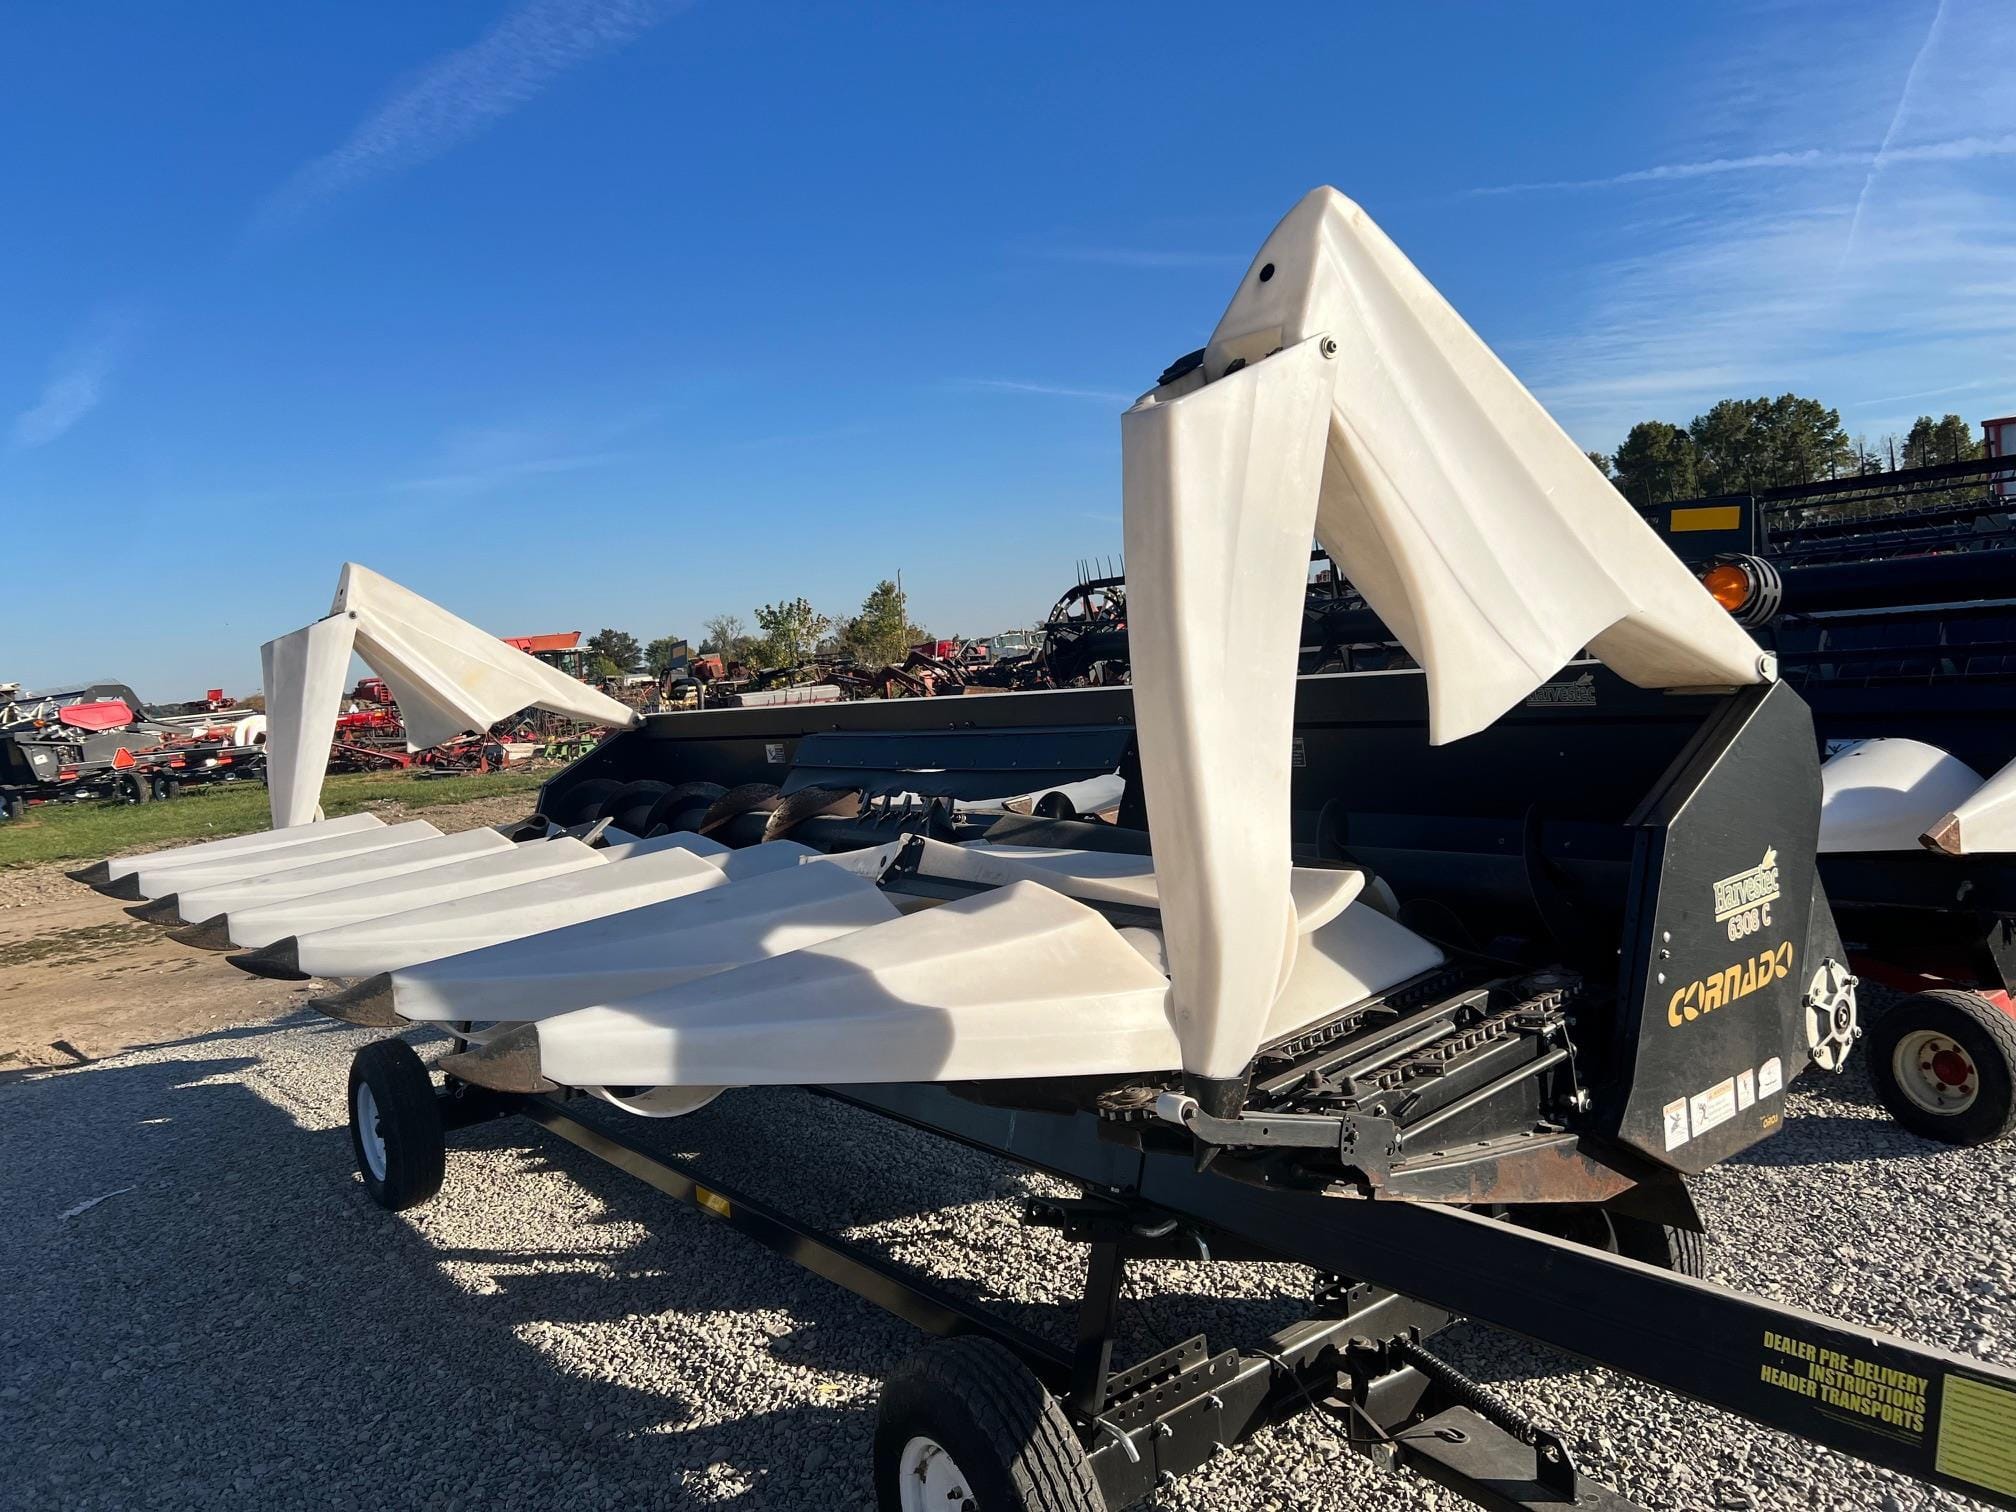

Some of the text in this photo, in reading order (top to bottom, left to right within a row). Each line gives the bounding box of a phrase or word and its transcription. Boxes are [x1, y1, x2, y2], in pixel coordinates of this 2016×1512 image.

[1713, 865, 1780, 915] Harvestec
[1728, 902, 1771, 942] 6308 C
[1667, 940, 1793, 1028] CORNADO
[1763, 1331, 1929, 1396] DEALER PRE-DELIVERY
[1808, 1363, 1926, 1415] INSTRUCTIONS
[1761, 1364, 1817, 1399] HEADER
[1820, 1384, 1925, 1433] TRANSPORTS
